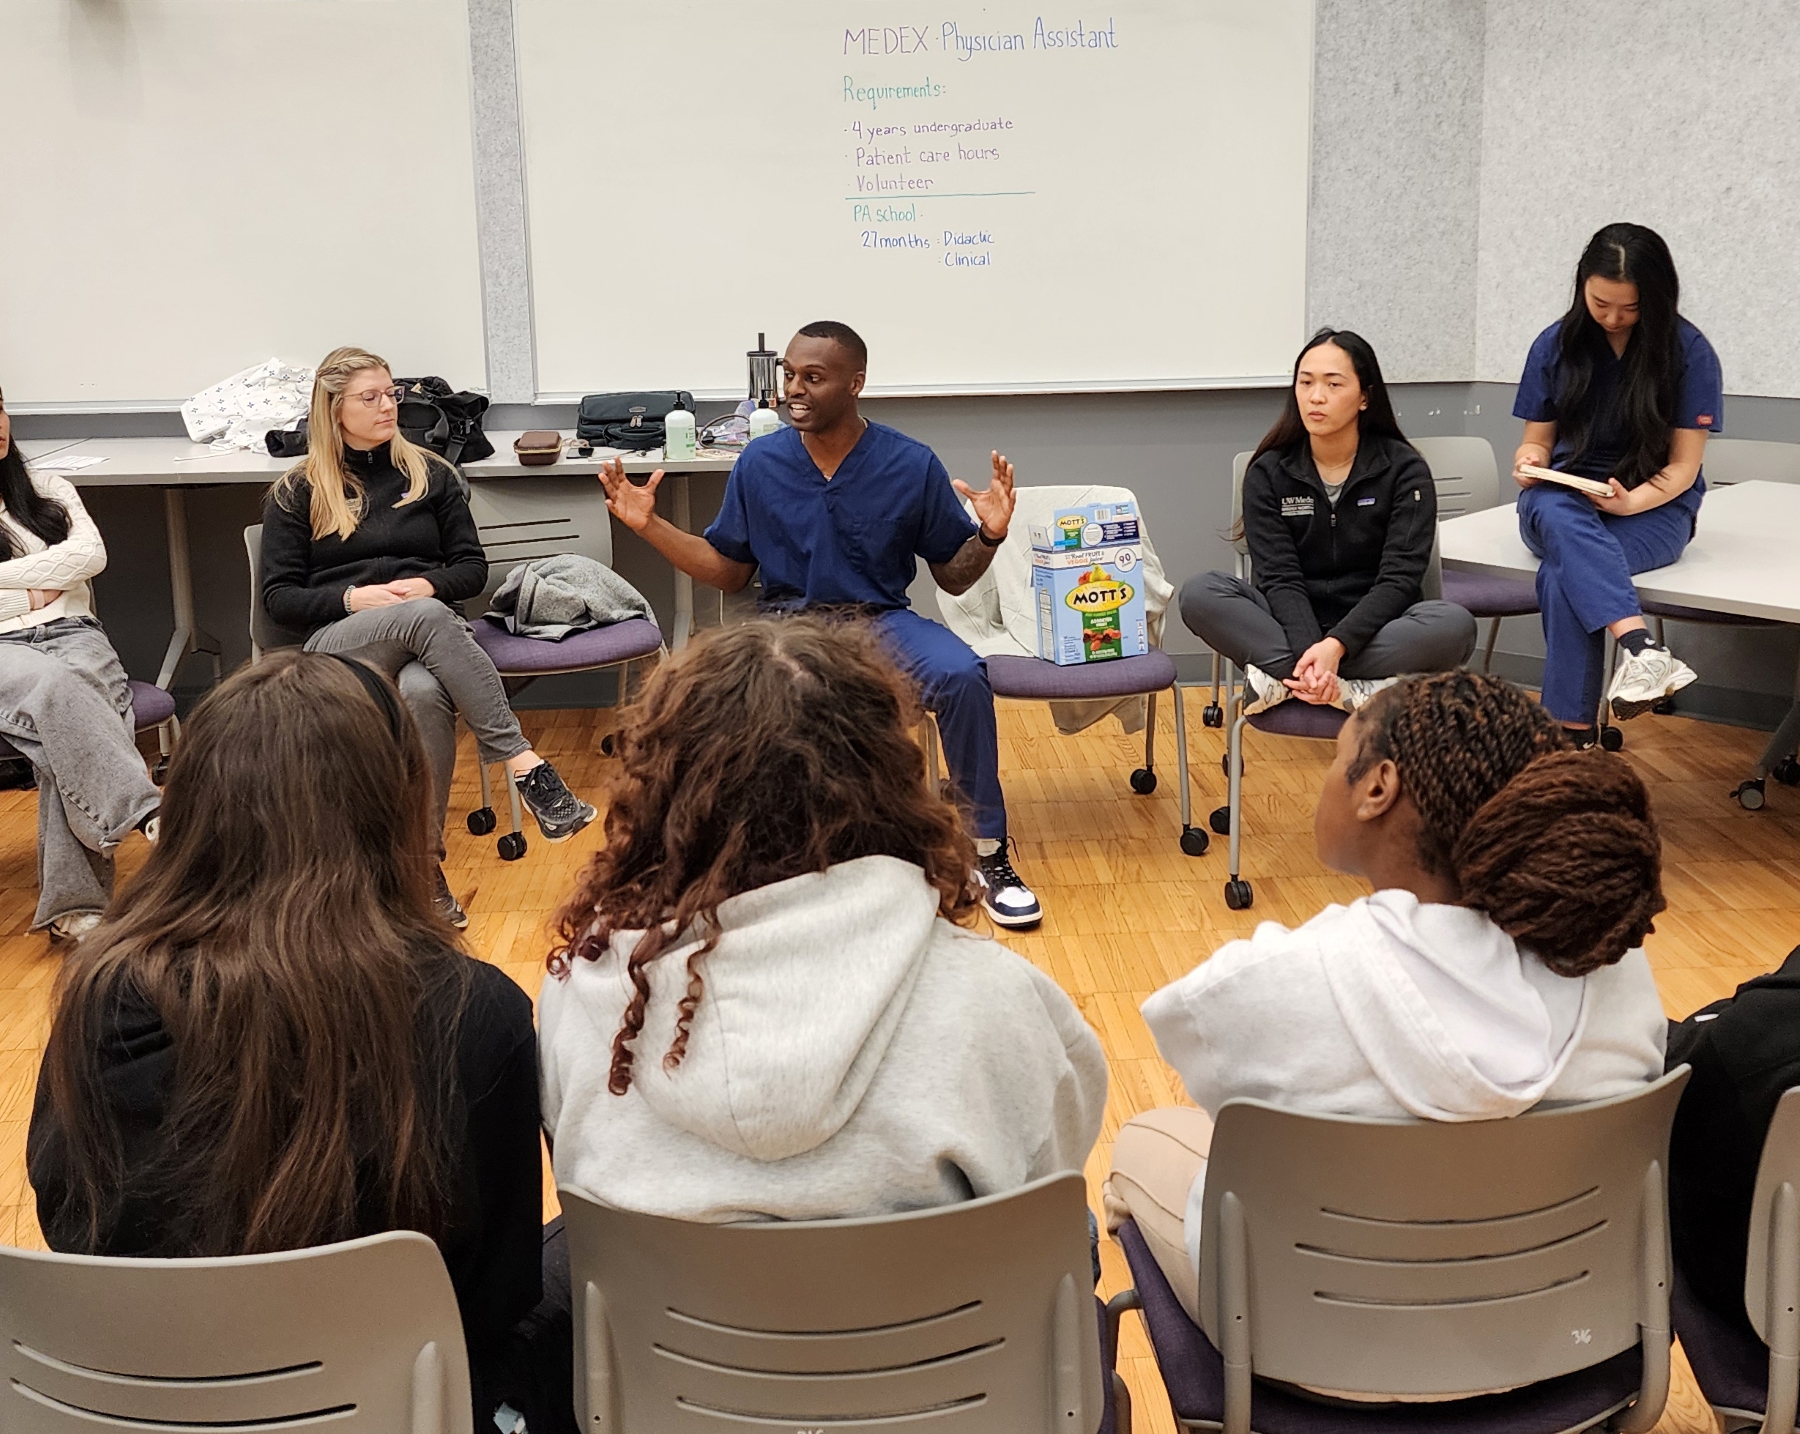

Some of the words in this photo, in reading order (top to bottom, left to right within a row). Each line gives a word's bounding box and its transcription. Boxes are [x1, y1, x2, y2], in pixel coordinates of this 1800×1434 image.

[843, 25, 929, 55] MEDEX
[941, 21, 1025, 62] Physician
[1032, 16, 1119, 50] Assistant
[843, 75, 946, 110] Requirements:
[852, 120, 863, 139] 4
[867, 127, 907, 145] years
[913, 117, 1014, 137] undergraduate
[856, 145, 912, 167] Patient
[919, 150, 950, 163] care
[957, 142, 1000, 161] hours
[856, 173, 934, 192] Volunteer
[854, 204, 872, 222] PA
[944, 251, 991, 267] Clinical
[1119, 553, 1131, 564] 90
